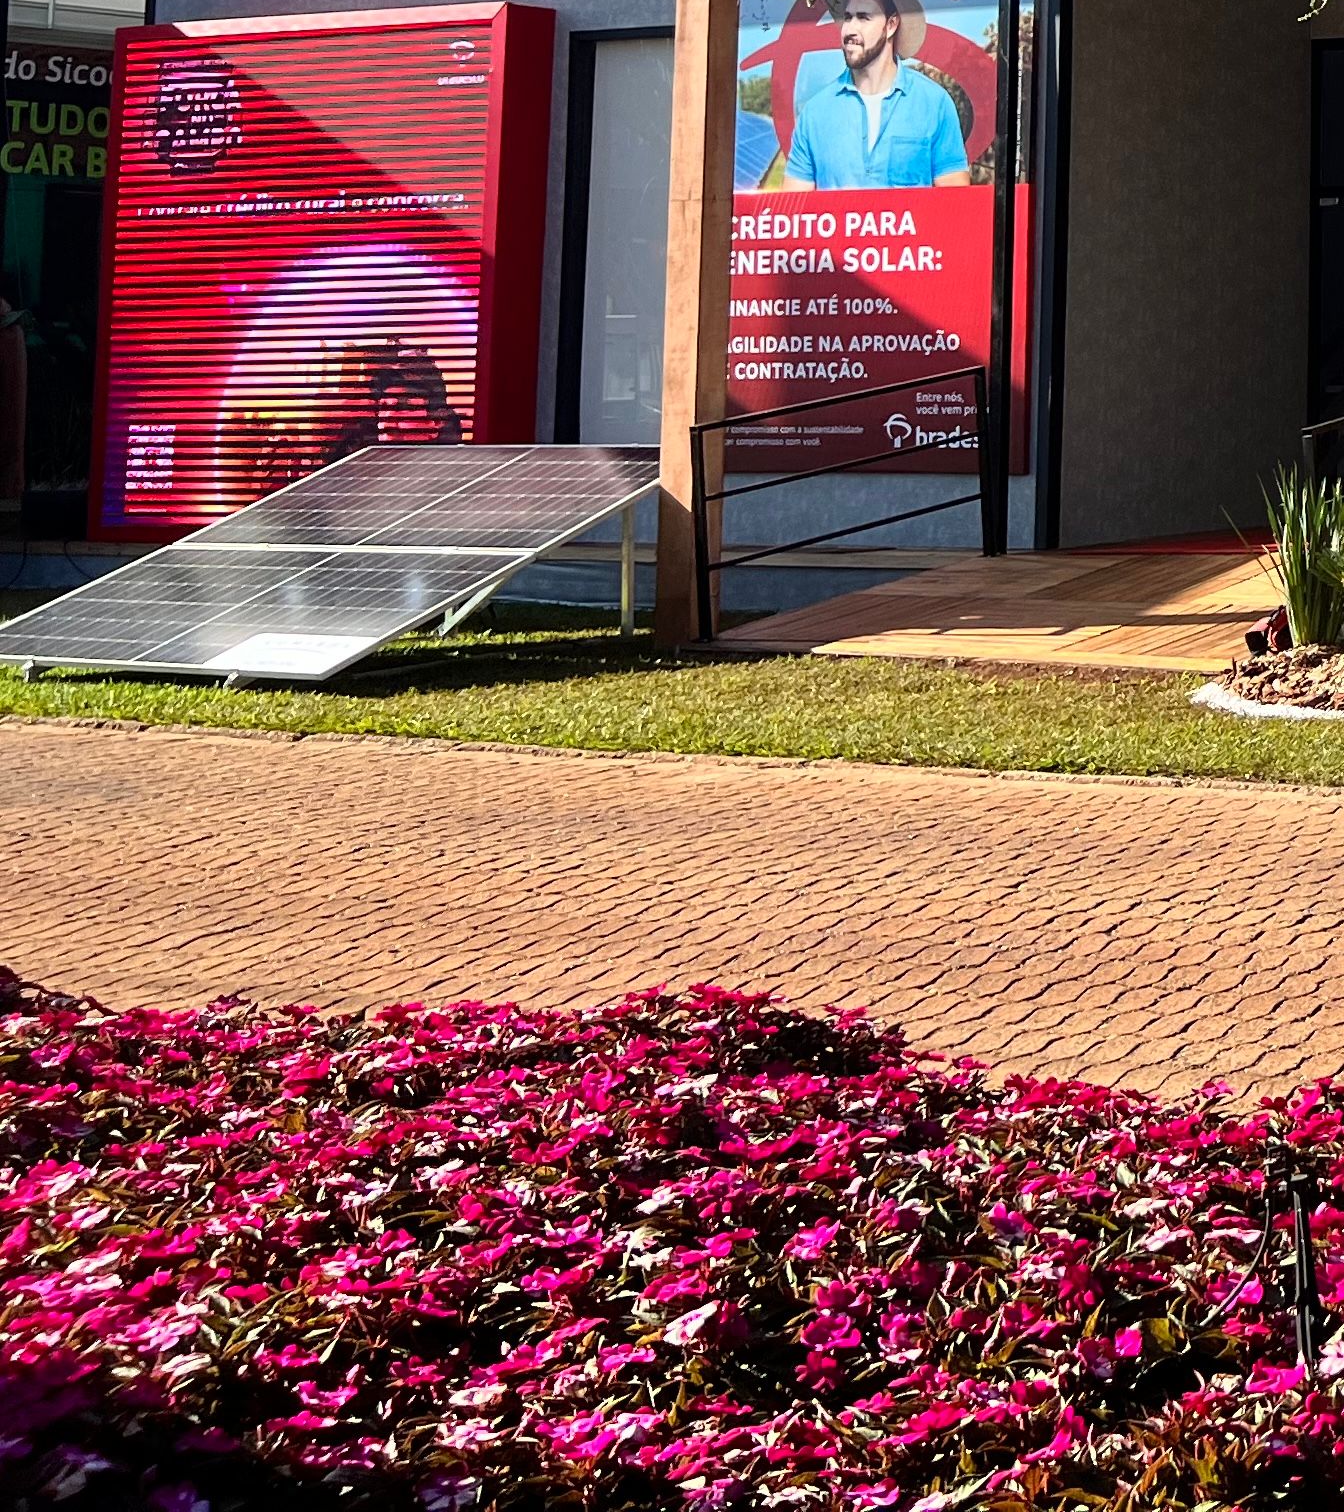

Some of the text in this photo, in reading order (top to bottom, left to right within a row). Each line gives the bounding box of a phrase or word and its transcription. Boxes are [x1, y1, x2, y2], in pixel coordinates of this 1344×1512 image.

[45, 55, 113, 86] Sico
[6, 99, 110, 138] TUDO
[1, 140, 75, 176] CAR
[845, 211, 917, 238] PARA
[843, 245, 943, 273] SOLAR:
[730, 294, 898, 317] INANCIE ATÉ 100%.
[818, 335, 844, 353] NA
[850, 329, 961, 356] APROVAÇÃO
[735, 358, 868, 383] CONTRATAÇÃO.
[916, 390, 965, 404] Entre nós,
[916, 403, 939, 415] você
[941, 406, 962, 415] vem
